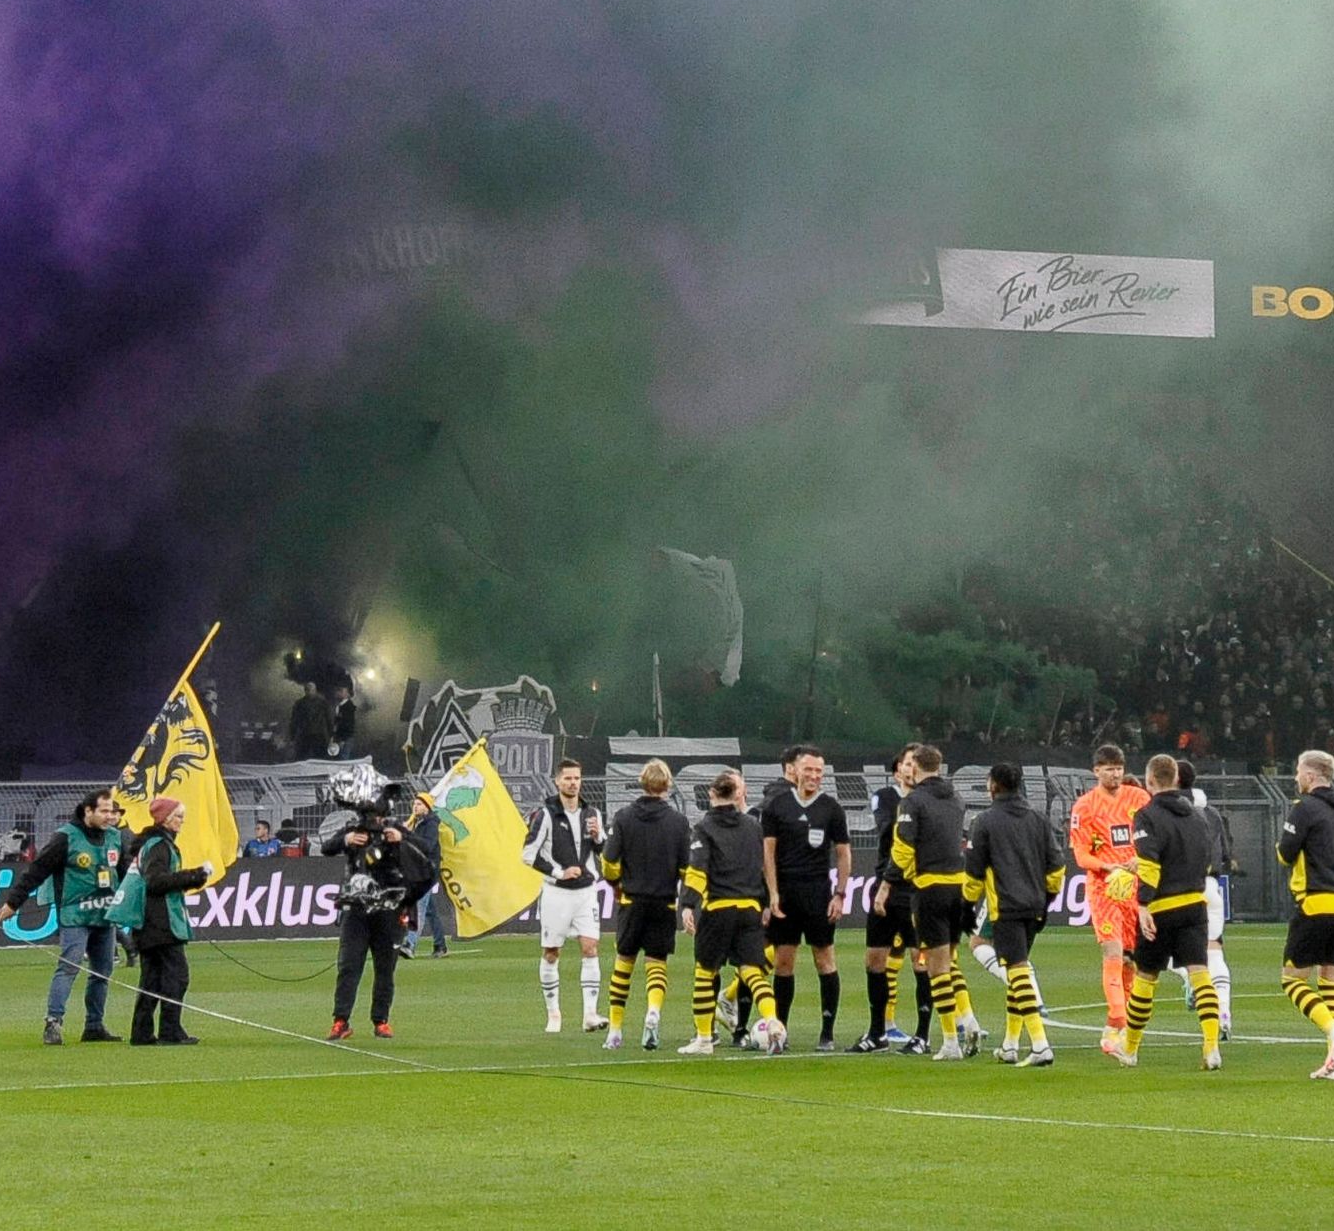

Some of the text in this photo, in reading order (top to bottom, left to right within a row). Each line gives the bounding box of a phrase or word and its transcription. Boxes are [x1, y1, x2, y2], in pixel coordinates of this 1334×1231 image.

[996, 255, 1104, 322] Ein Bier
[1023, 272, 1180, 330] wie sein Revier
[1111, 828, 1129, 842] 1&1
